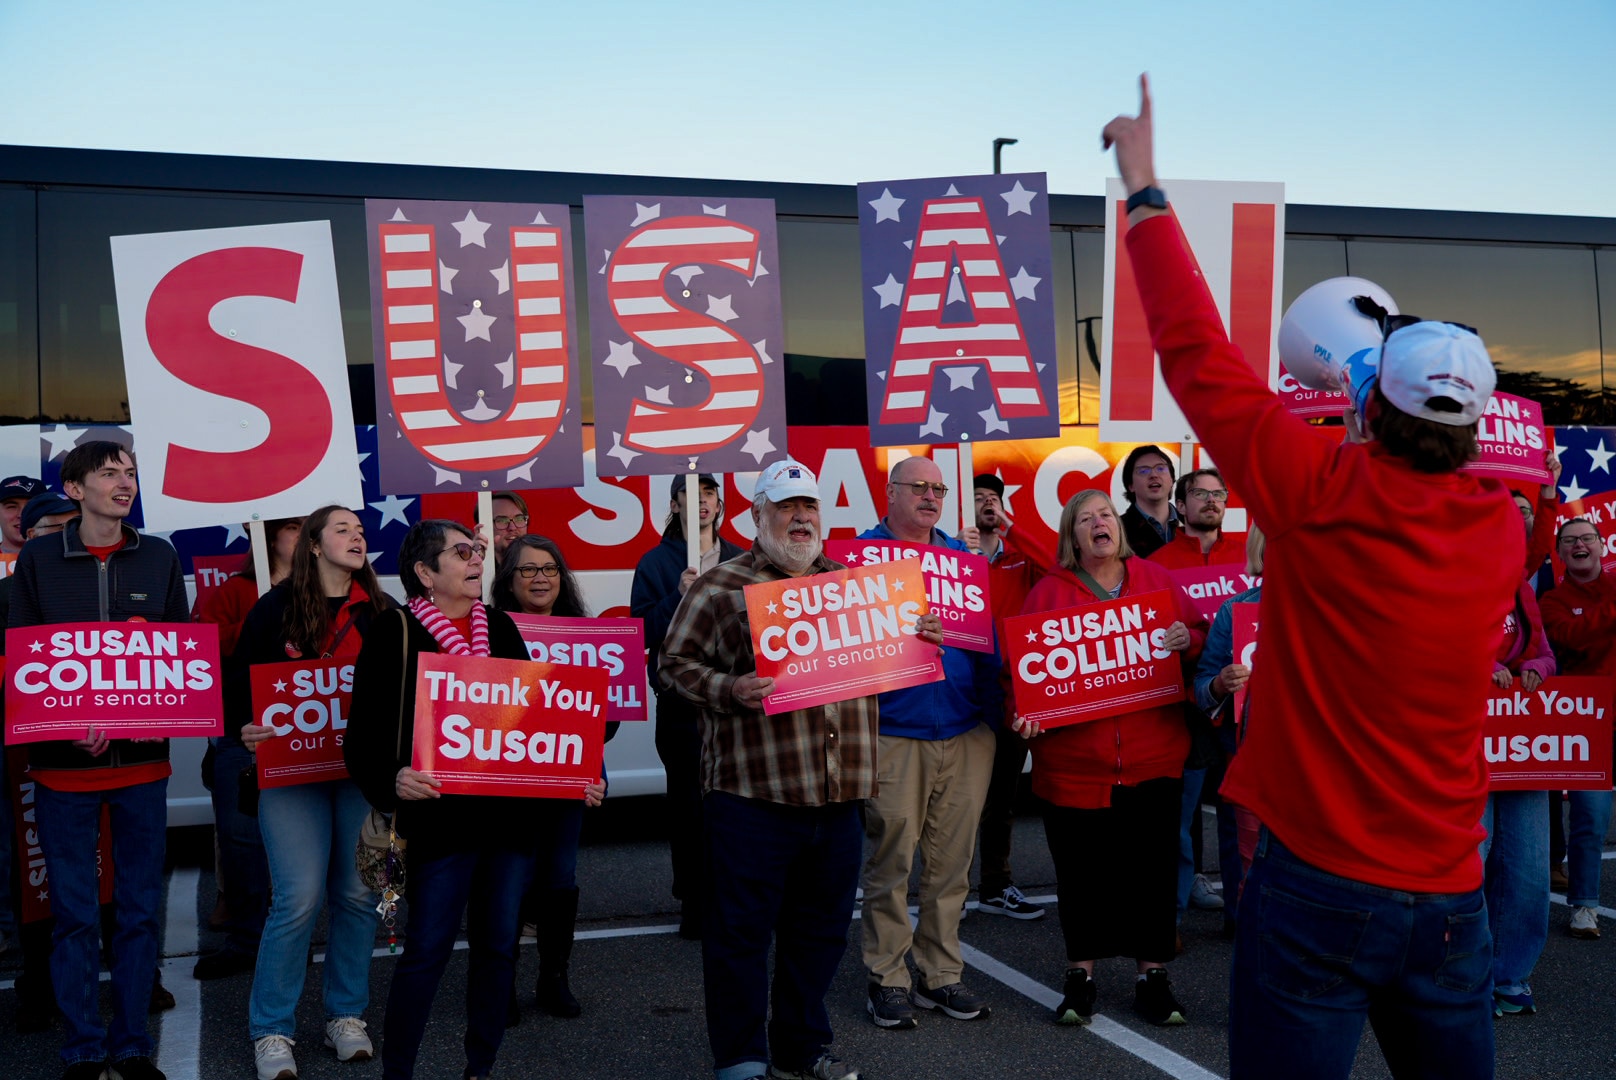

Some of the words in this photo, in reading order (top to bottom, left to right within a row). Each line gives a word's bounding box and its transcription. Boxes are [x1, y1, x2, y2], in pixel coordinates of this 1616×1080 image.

[878, 196, 1050, 425] A
[378, 223, 569, 472] U
[607, 215, 765, 455] S
[145, 246, 334, 504] S
[1477, 417, 1543, 450] LINS
[781, 573, 889, 619] SUSAN
[1181, 575, 1237, 599] ank
[759, 600, 922, 662] COLLINS
[930, 606, 966, 622] ator
[1041, 603, 1143, 647] SUSAN
[50, 629, 178, 658] SUSAN
[787, 656, 819, 676] our
[828, 640, 904, 668] senator
[1018, 628, 1172, 684] COLLINS
[14, 659, 214, 694] COLLINS
[292, 664, 356, 698] SUS
[424, 670, 530, 707] Thank
[538, 679, 600, 717] You,
[1045, 679, 1076, 697] our
[1084, 665, 1155, 690] senator
[43, 694, 84, 708] our
[94, 691, 187, 706] senator
[1537, 690, 1605, 720] You,
[290, 736, 326, 751] our
[438, 713, 584, 765] Susan
[1484, 734, 1590, 763] usan
